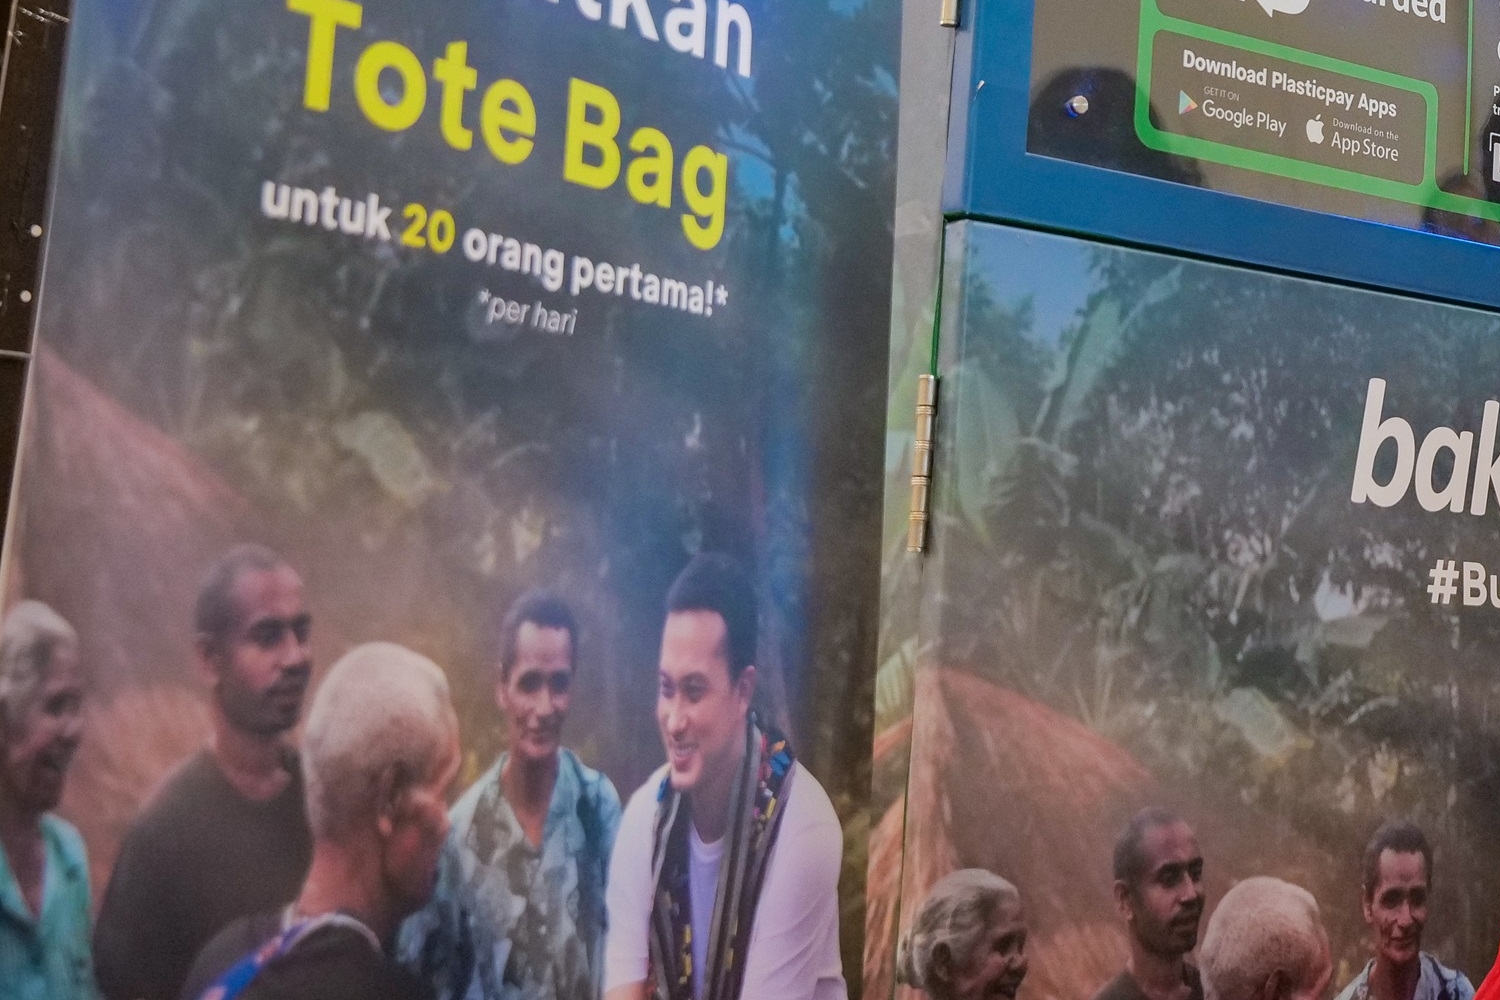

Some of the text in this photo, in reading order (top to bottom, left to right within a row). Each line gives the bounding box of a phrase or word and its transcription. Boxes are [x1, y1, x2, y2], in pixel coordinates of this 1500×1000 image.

[1183, 49, 1397, 118] Download Plasticpay Apps
[1204, 86, 1240, 102] GET IT ON
[1202, 99, 1287, 138] Google Play
[1333, 118, 1399, 141] Download on the
[563, 77, 728, 250] Bag
[1331, 131, 1399, 162] App Store
[262, 179, 391, 241] untuk
[402, 203, 454, 253] 20
[464, 227, 563, 289] orang
[533, 298, 577, 335] hari
